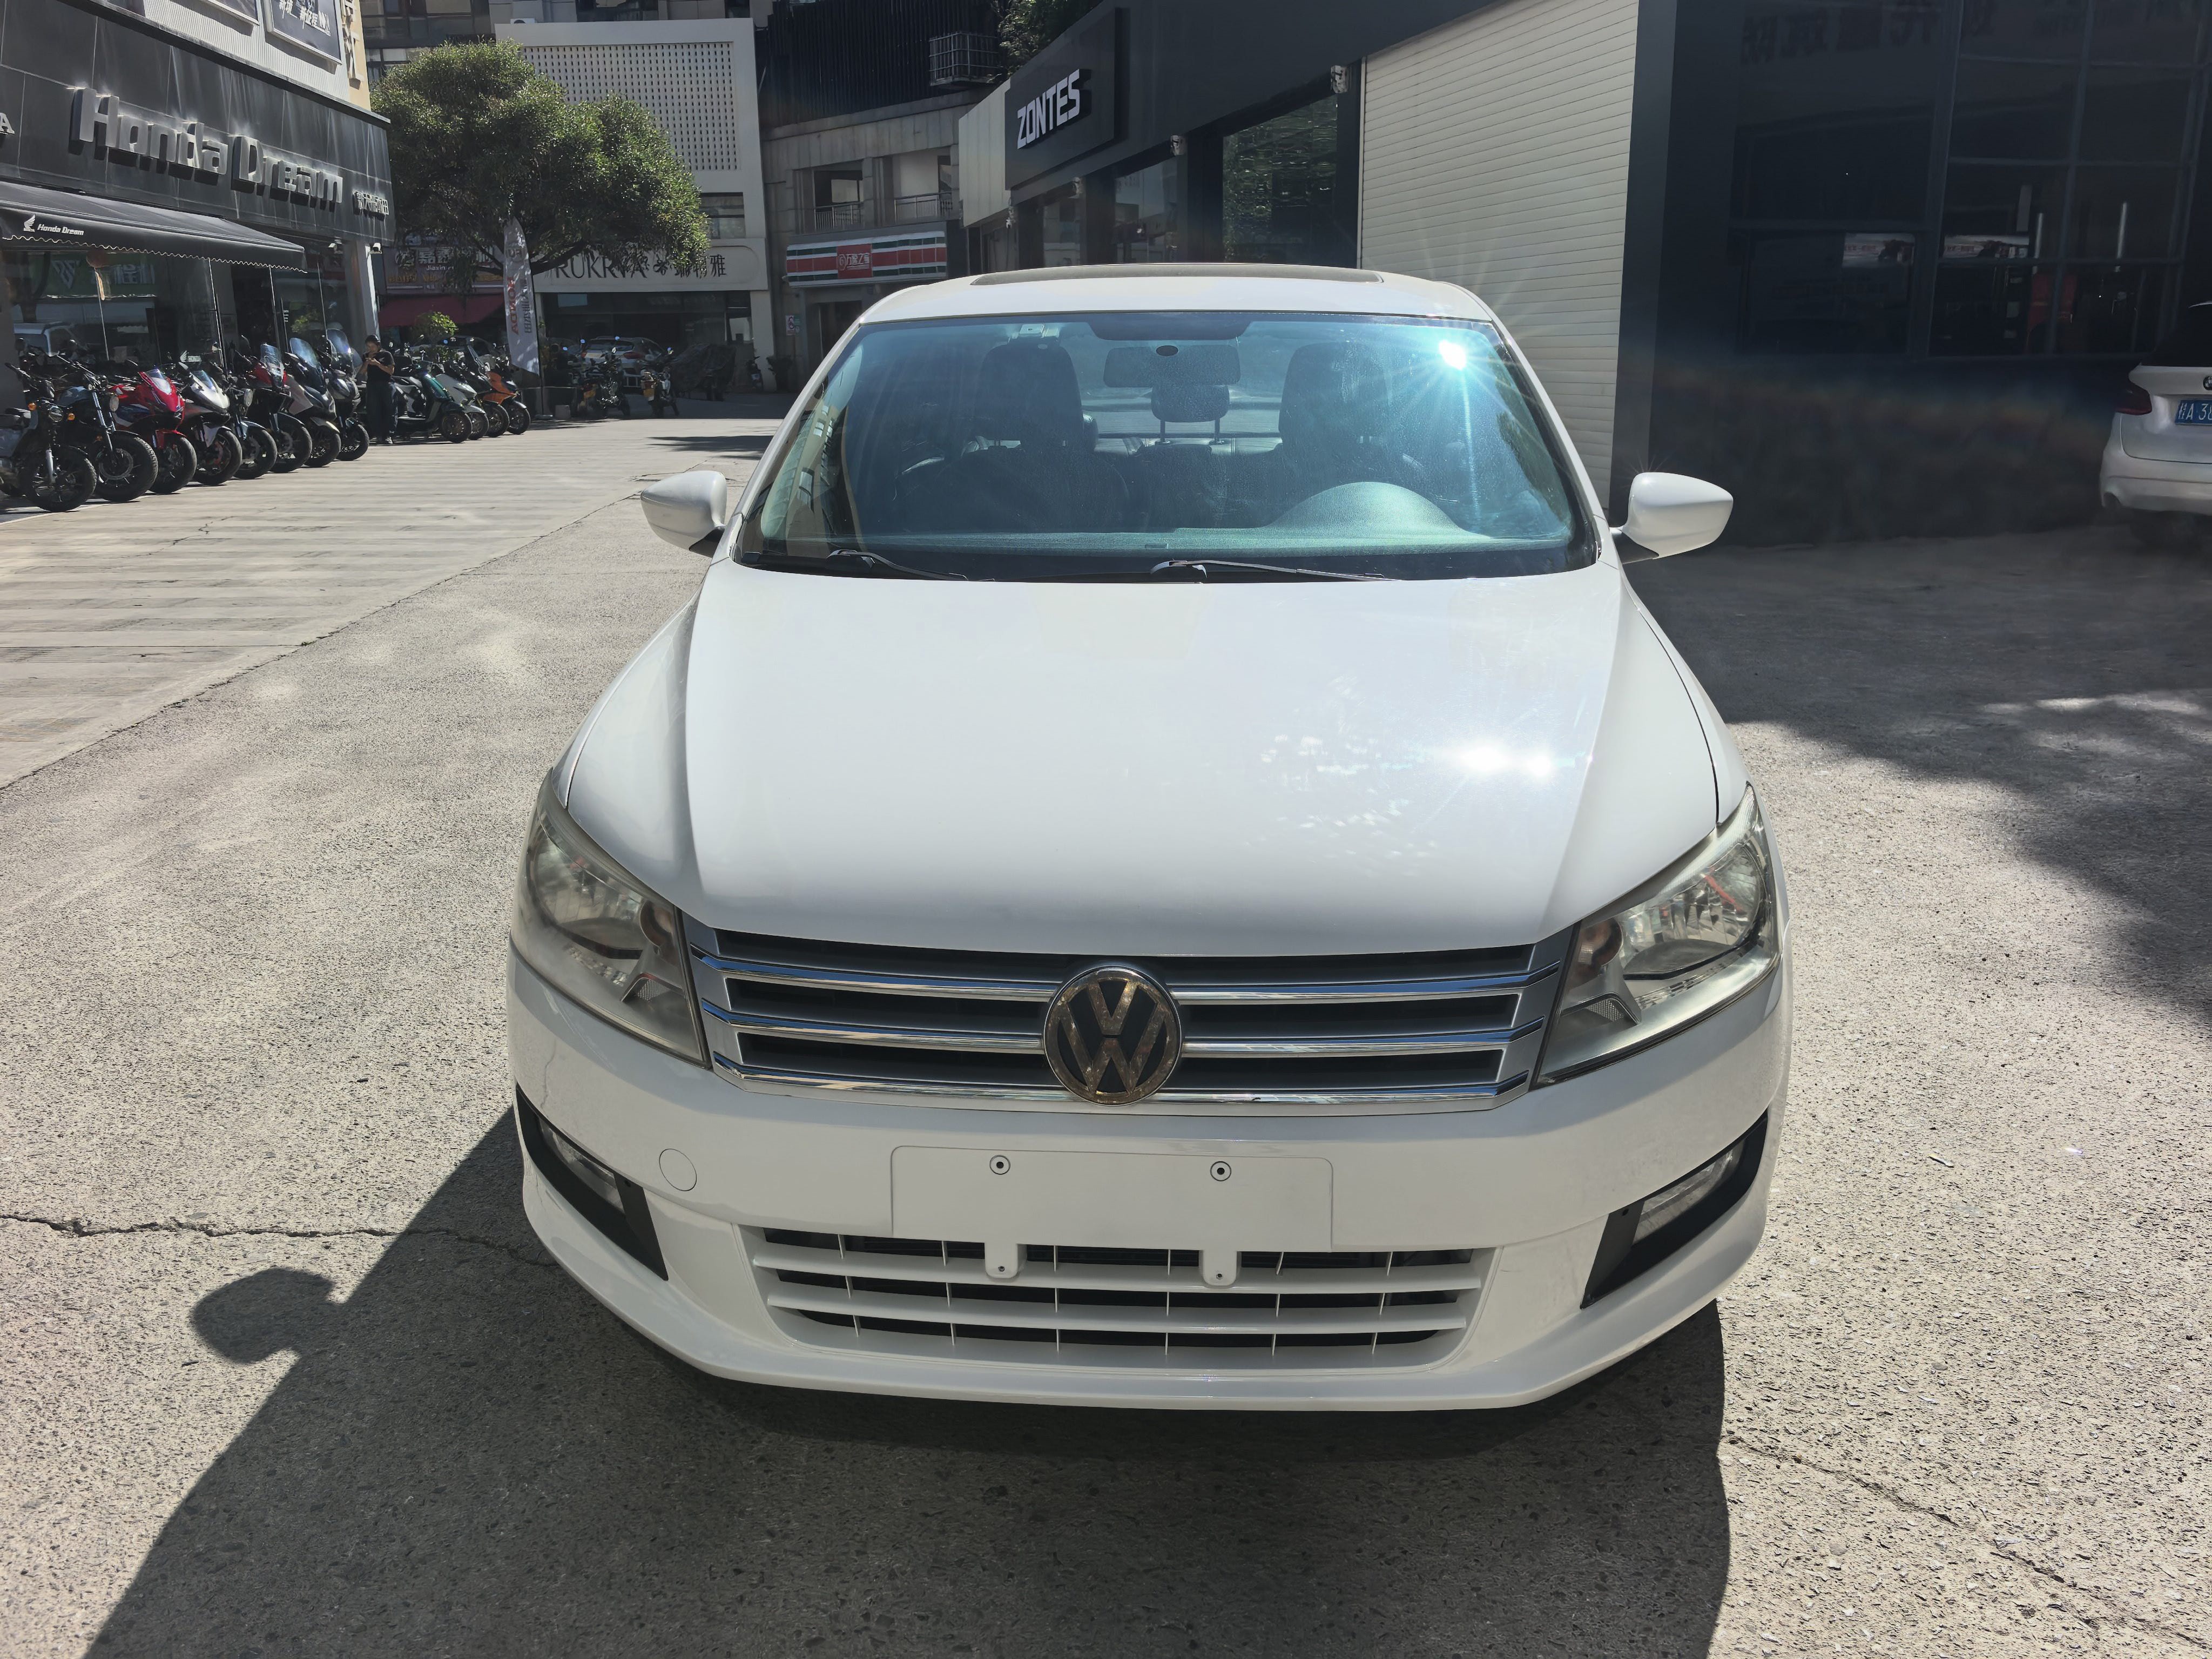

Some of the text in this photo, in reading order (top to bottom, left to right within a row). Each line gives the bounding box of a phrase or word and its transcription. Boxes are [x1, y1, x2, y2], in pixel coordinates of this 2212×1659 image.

[75, 86, 343, 204] Honda Dream
[1017, 69, 1080, 150] ZONTES
[37, 224, 84, 235] Honda Dream
